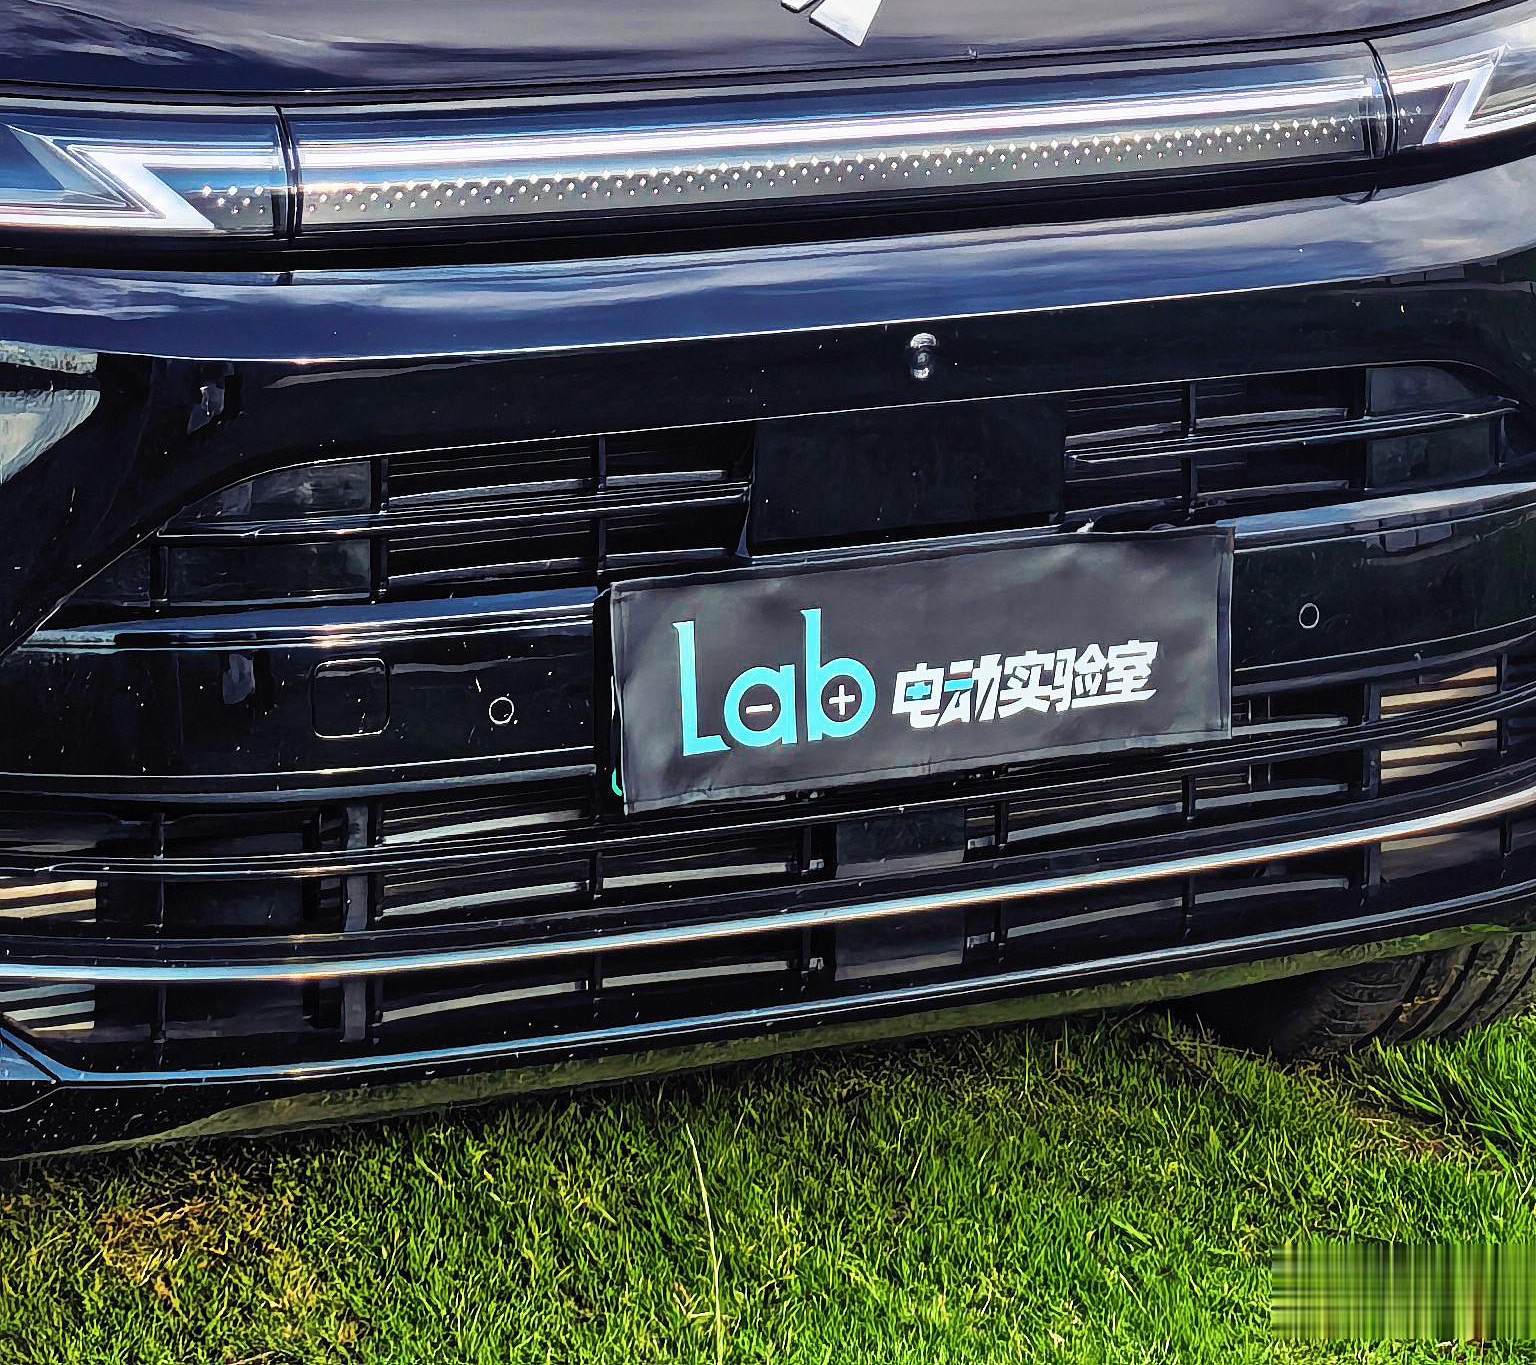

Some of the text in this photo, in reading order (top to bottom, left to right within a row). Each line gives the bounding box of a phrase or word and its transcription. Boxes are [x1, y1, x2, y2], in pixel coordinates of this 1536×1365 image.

[672, 608, 1159, 757] Lab 电动实验室
